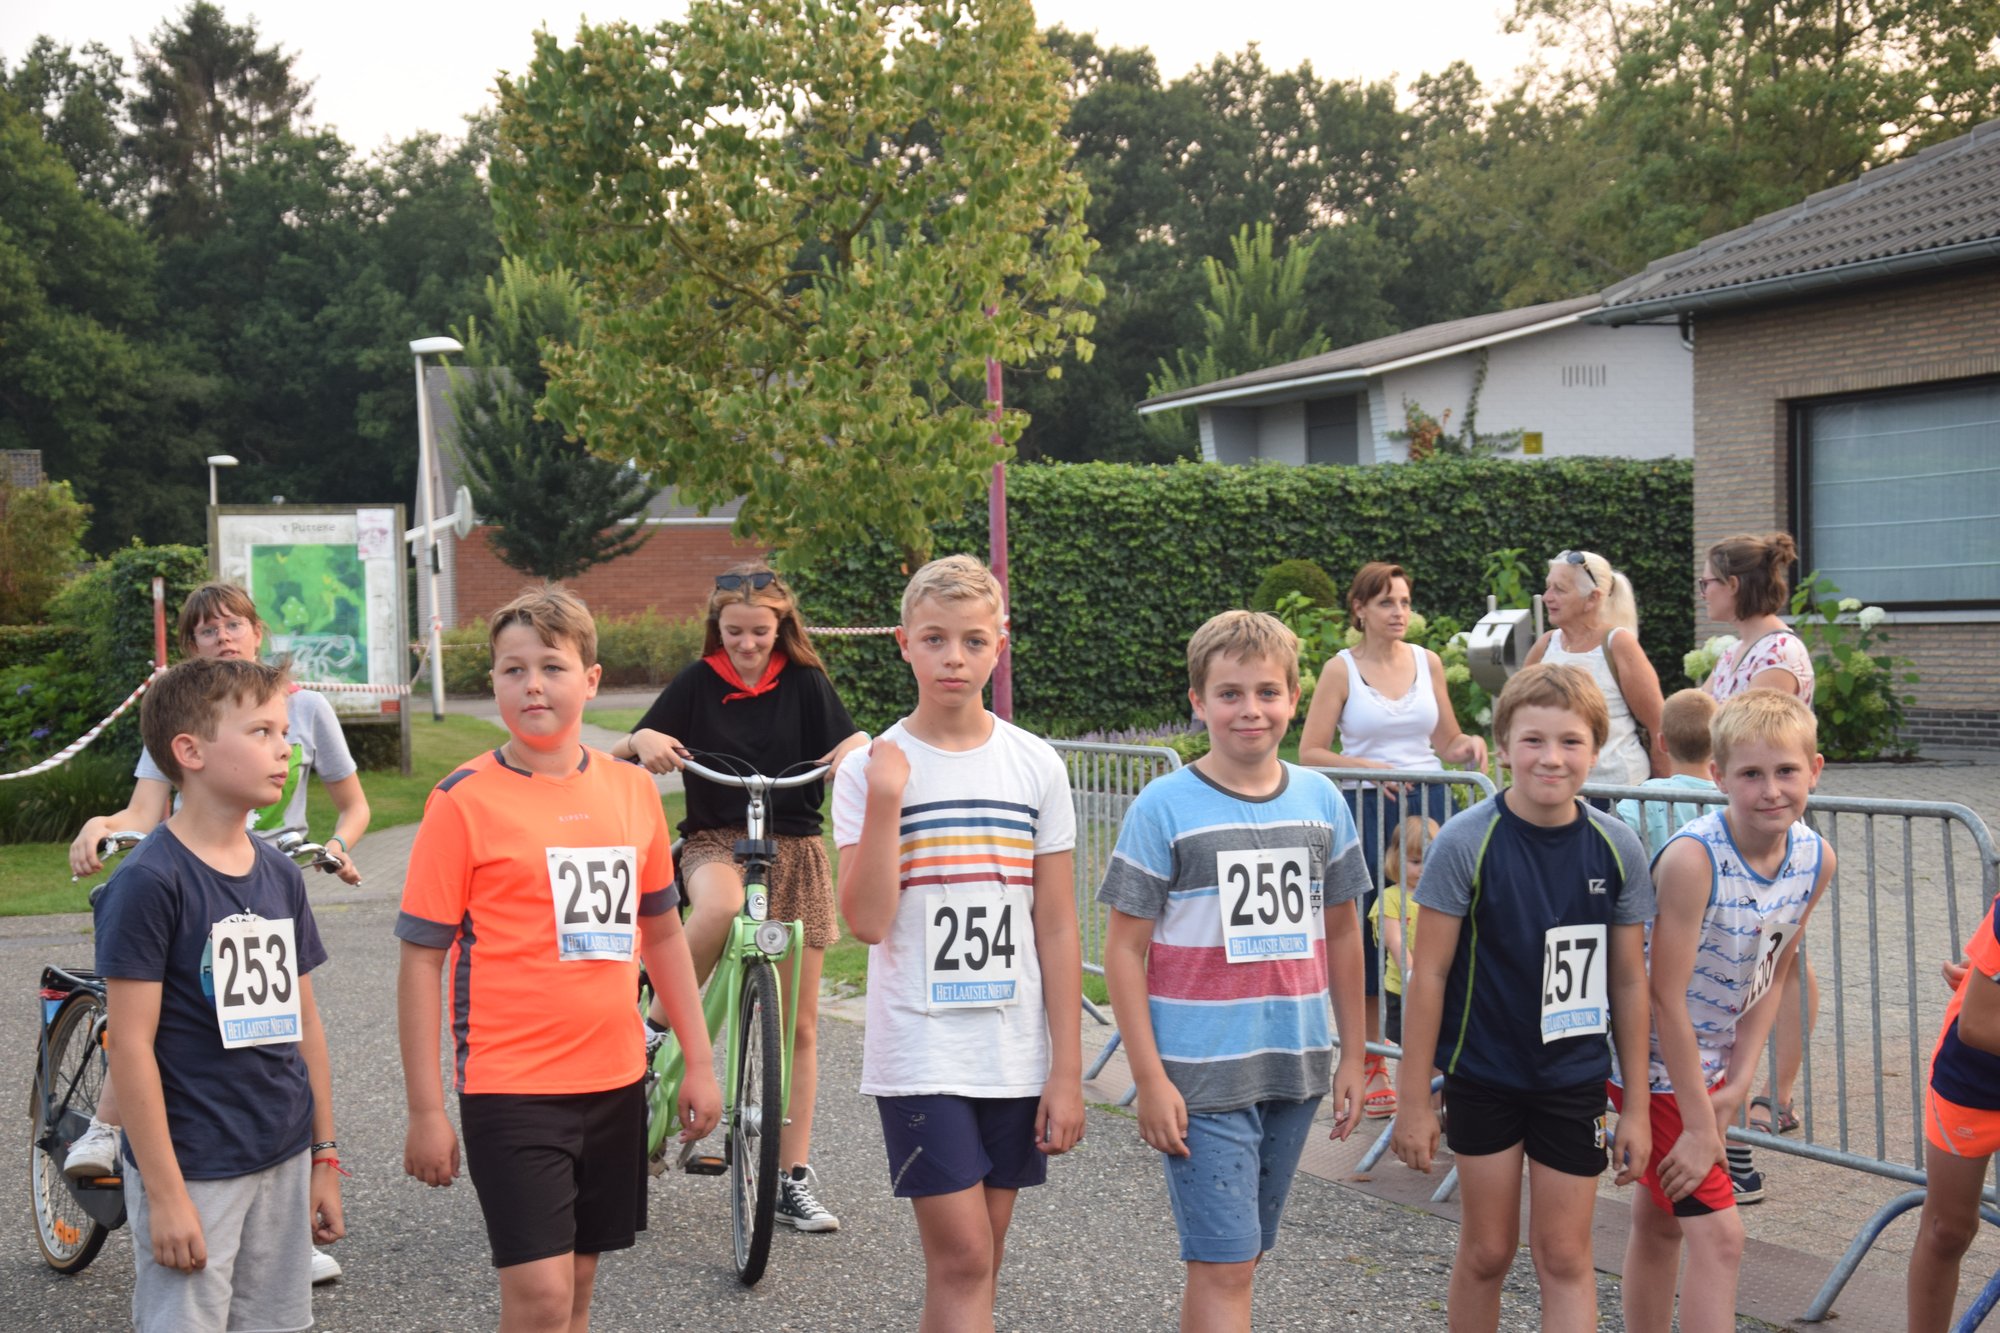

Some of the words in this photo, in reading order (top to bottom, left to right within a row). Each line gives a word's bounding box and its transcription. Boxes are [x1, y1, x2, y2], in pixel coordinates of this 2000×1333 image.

[558, 859, 631, 925] 252
[1227, 860, 1304, 926] 256
[219, 933, 292, 1007] 253
[567, 935, 584, 951] HET
[933, 904, 1015, 971] 254
[1231, 939, 1247, 955] HET
[1248, 938, 1278, 954] LAATSTE
[1279, 936, 1304, 951] NIEUWS
[936, 984, 952, 1001] HET
[953, 984, 987, 1000] LAATSTE
[987, 983, 1012, 999] NIEUWS
[1544, 938, 1598, 1006] 257
[227, 1022, 241, 1039] HET
